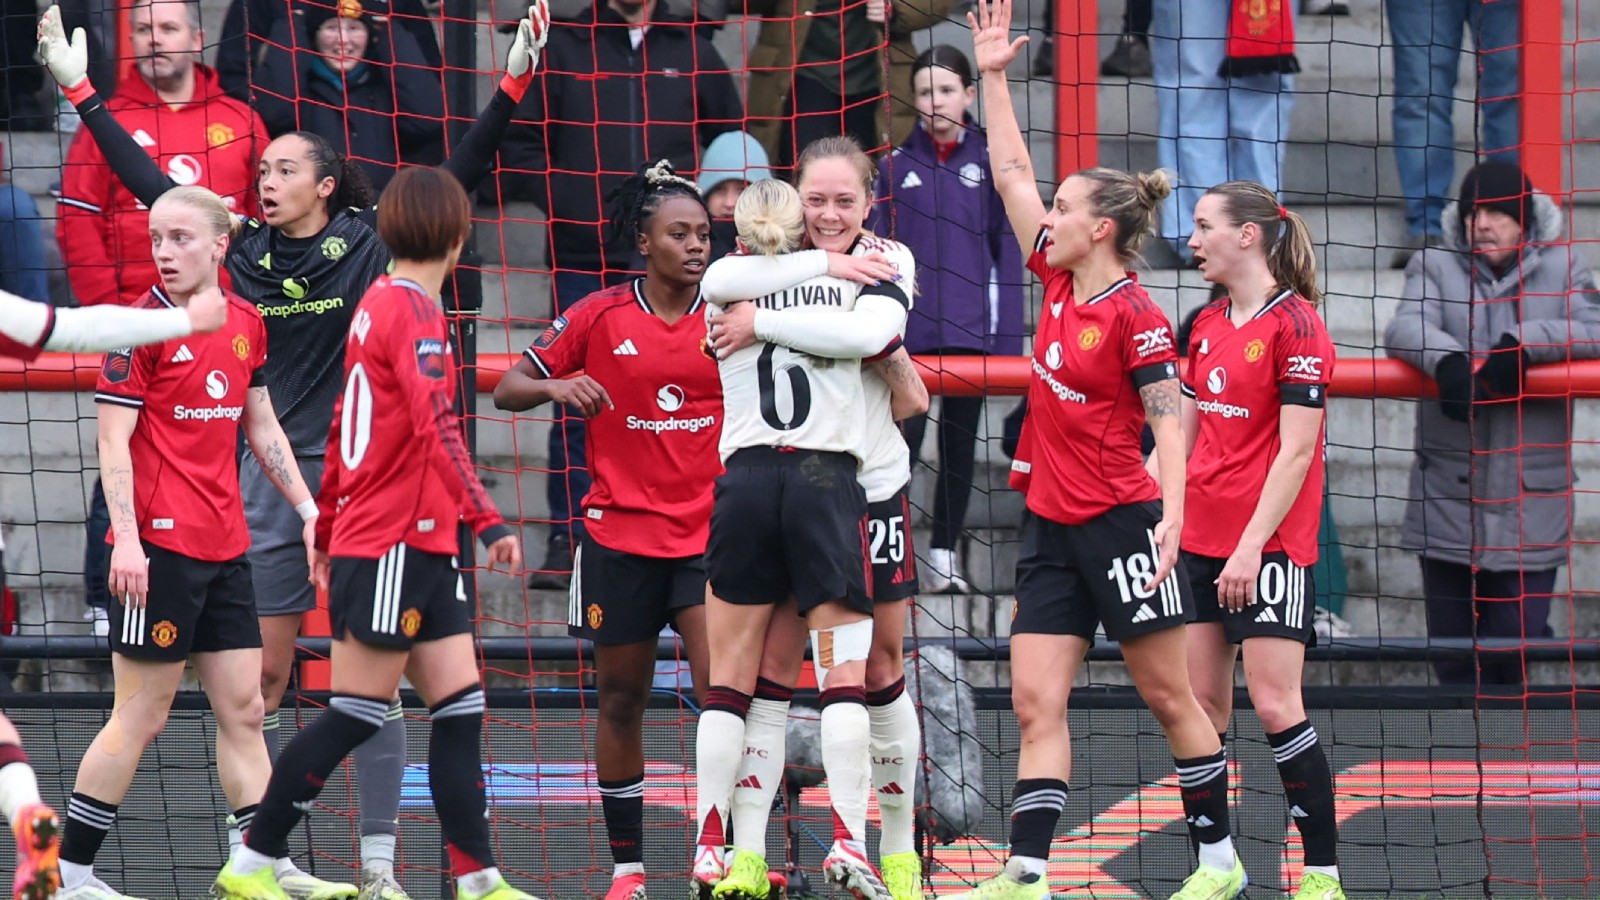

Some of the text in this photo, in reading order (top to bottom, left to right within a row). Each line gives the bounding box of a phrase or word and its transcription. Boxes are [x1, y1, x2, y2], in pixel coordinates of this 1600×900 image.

[256, 297, 344, 318] Snapdragon
[750, 285, 842, 311] ULLIVAN
[1133, 327, 1171, 352] DXC
[1287, 355, 1323, 375] DXC
[757, 341, 812, 430] 6
[1031, 351, 1087, 405] napdragon
[173, 404, 244, 423] Snapdrago
[626, 415, 715, 435] Snapdragon
[868, 515, 904, 564] 25
[1107, 552, 1157, 603] 18
[1252, 561, 1286, 605] 0
[742, 746, 769, 760] FC
[872, 756, 904, 766] LFC
